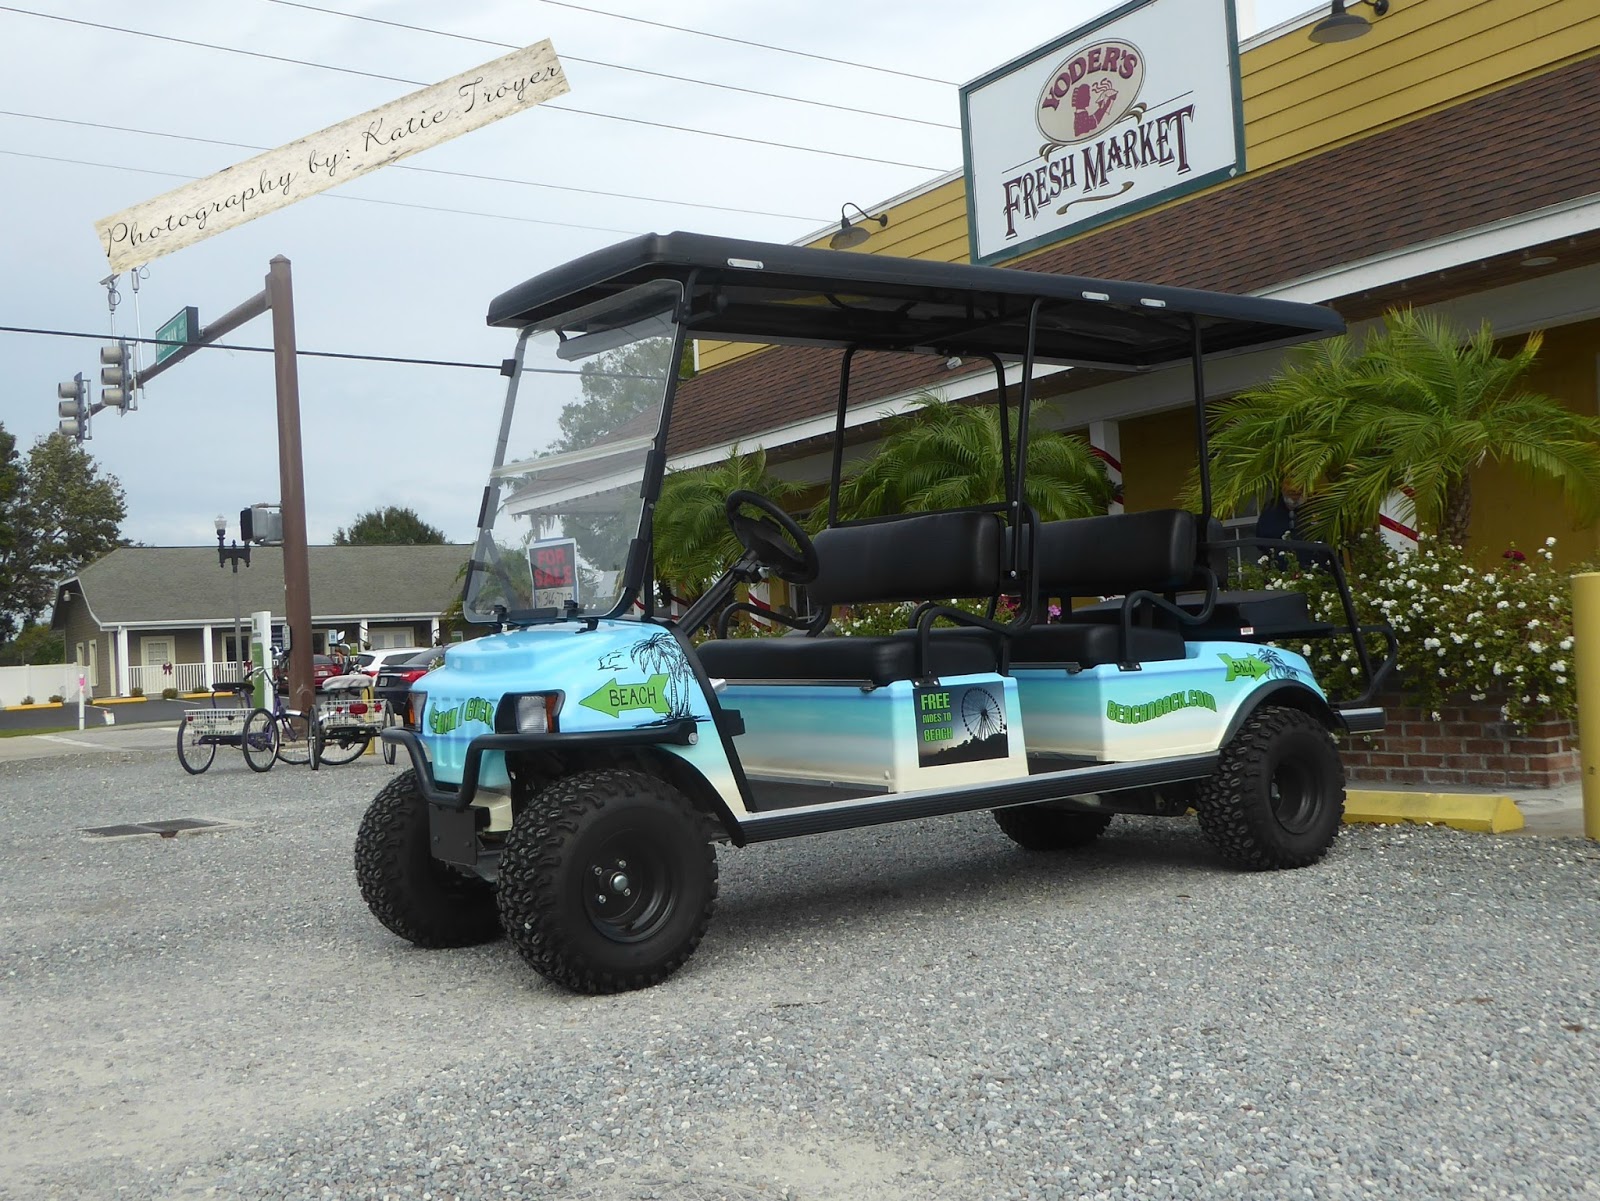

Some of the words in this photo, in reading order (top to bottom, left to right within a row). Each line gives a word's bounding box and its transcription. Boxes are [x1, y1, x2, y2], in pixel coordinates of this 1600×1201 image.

[1041, 46, 1138, 111] YODER'S
[1002, 153, 1077, 240] FRESH
[1081, 104, 1196, 194] MARKET
[538, 549, 565, 565] FOR
[534, 565, 573, 587] SALE
[1233, 661, 1256, 674] BACK
[609, 685, 657, 707] BEACH
[920, 693, 951, 711] FREE
[922, 713, 942, 724] RIDES
[943, 712, 952, 721] TO
[923, 727, 954, 742] BEACH
